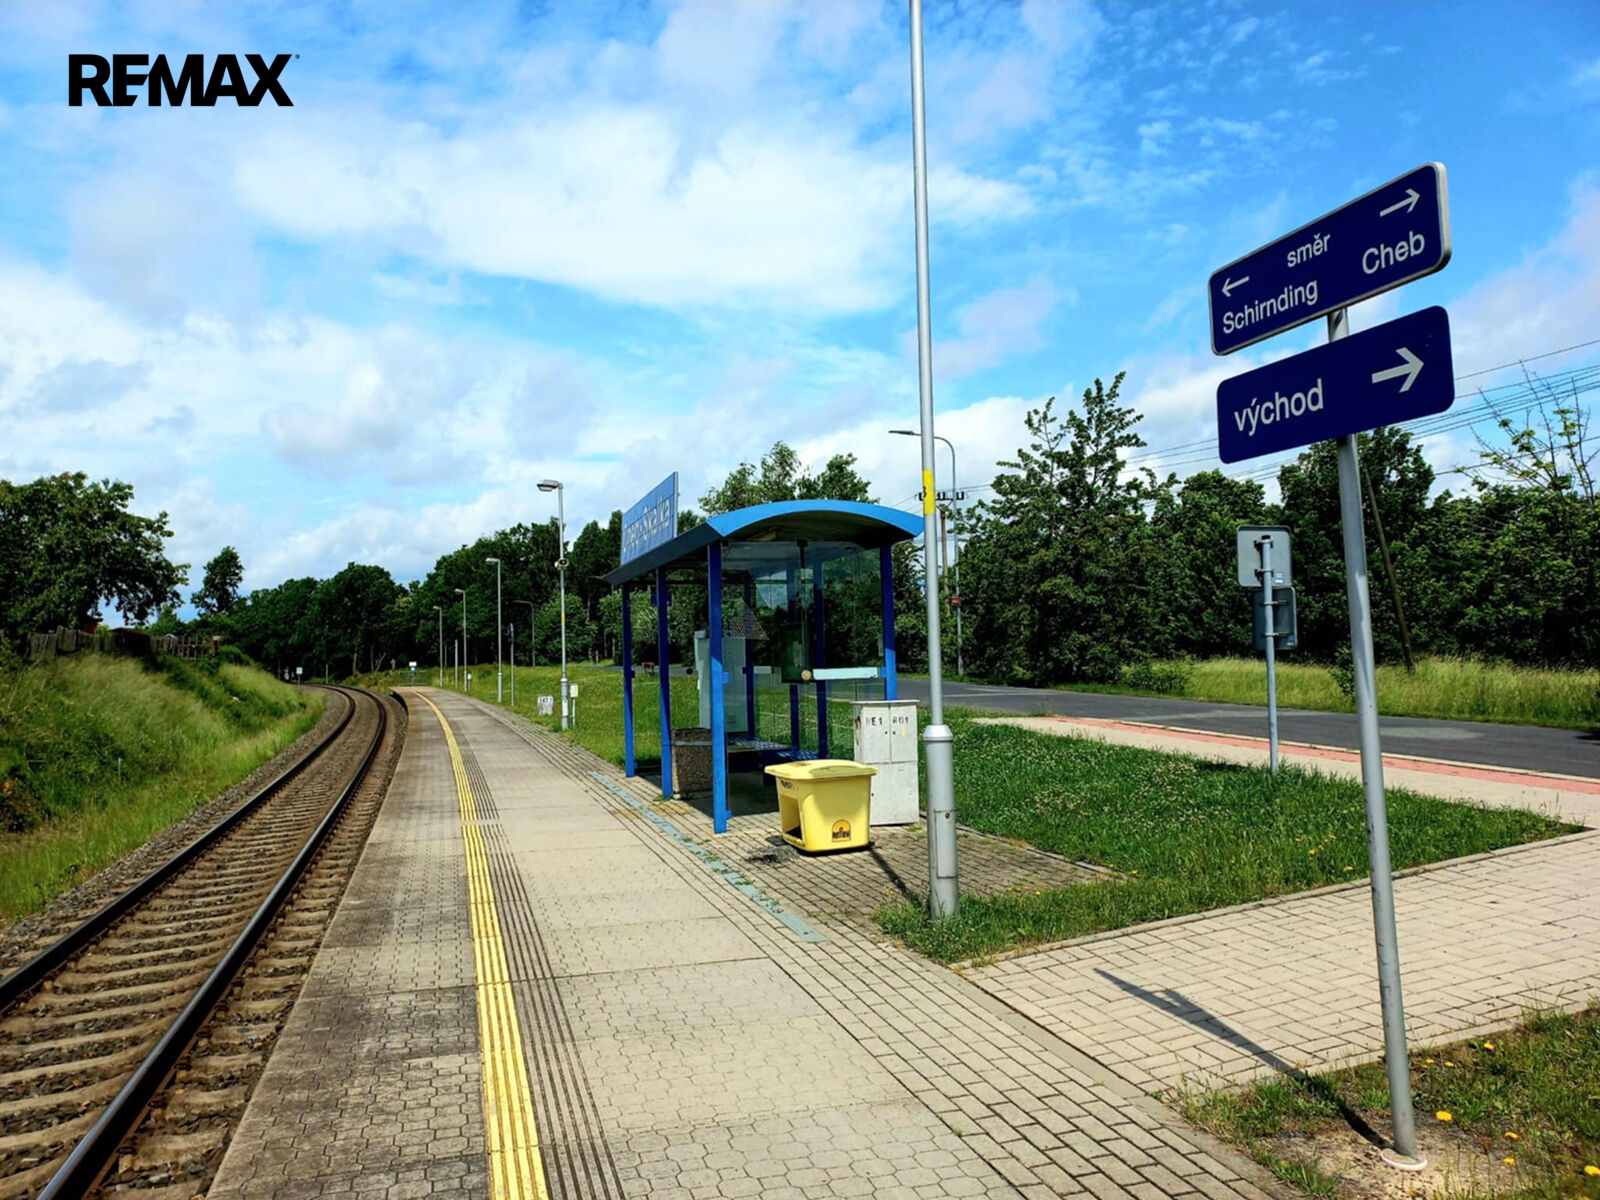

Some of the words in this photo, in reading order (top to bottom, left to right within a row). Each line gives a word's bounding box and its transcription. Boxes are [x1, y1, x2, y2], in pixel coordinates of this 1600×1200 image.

[1287, 233, 1330, 267] směr
[1362, 231, 1425, 274] Cheb
[1223, 280, 1318, 334] Schirnding
[1234, 378, 1324, 436] východ
